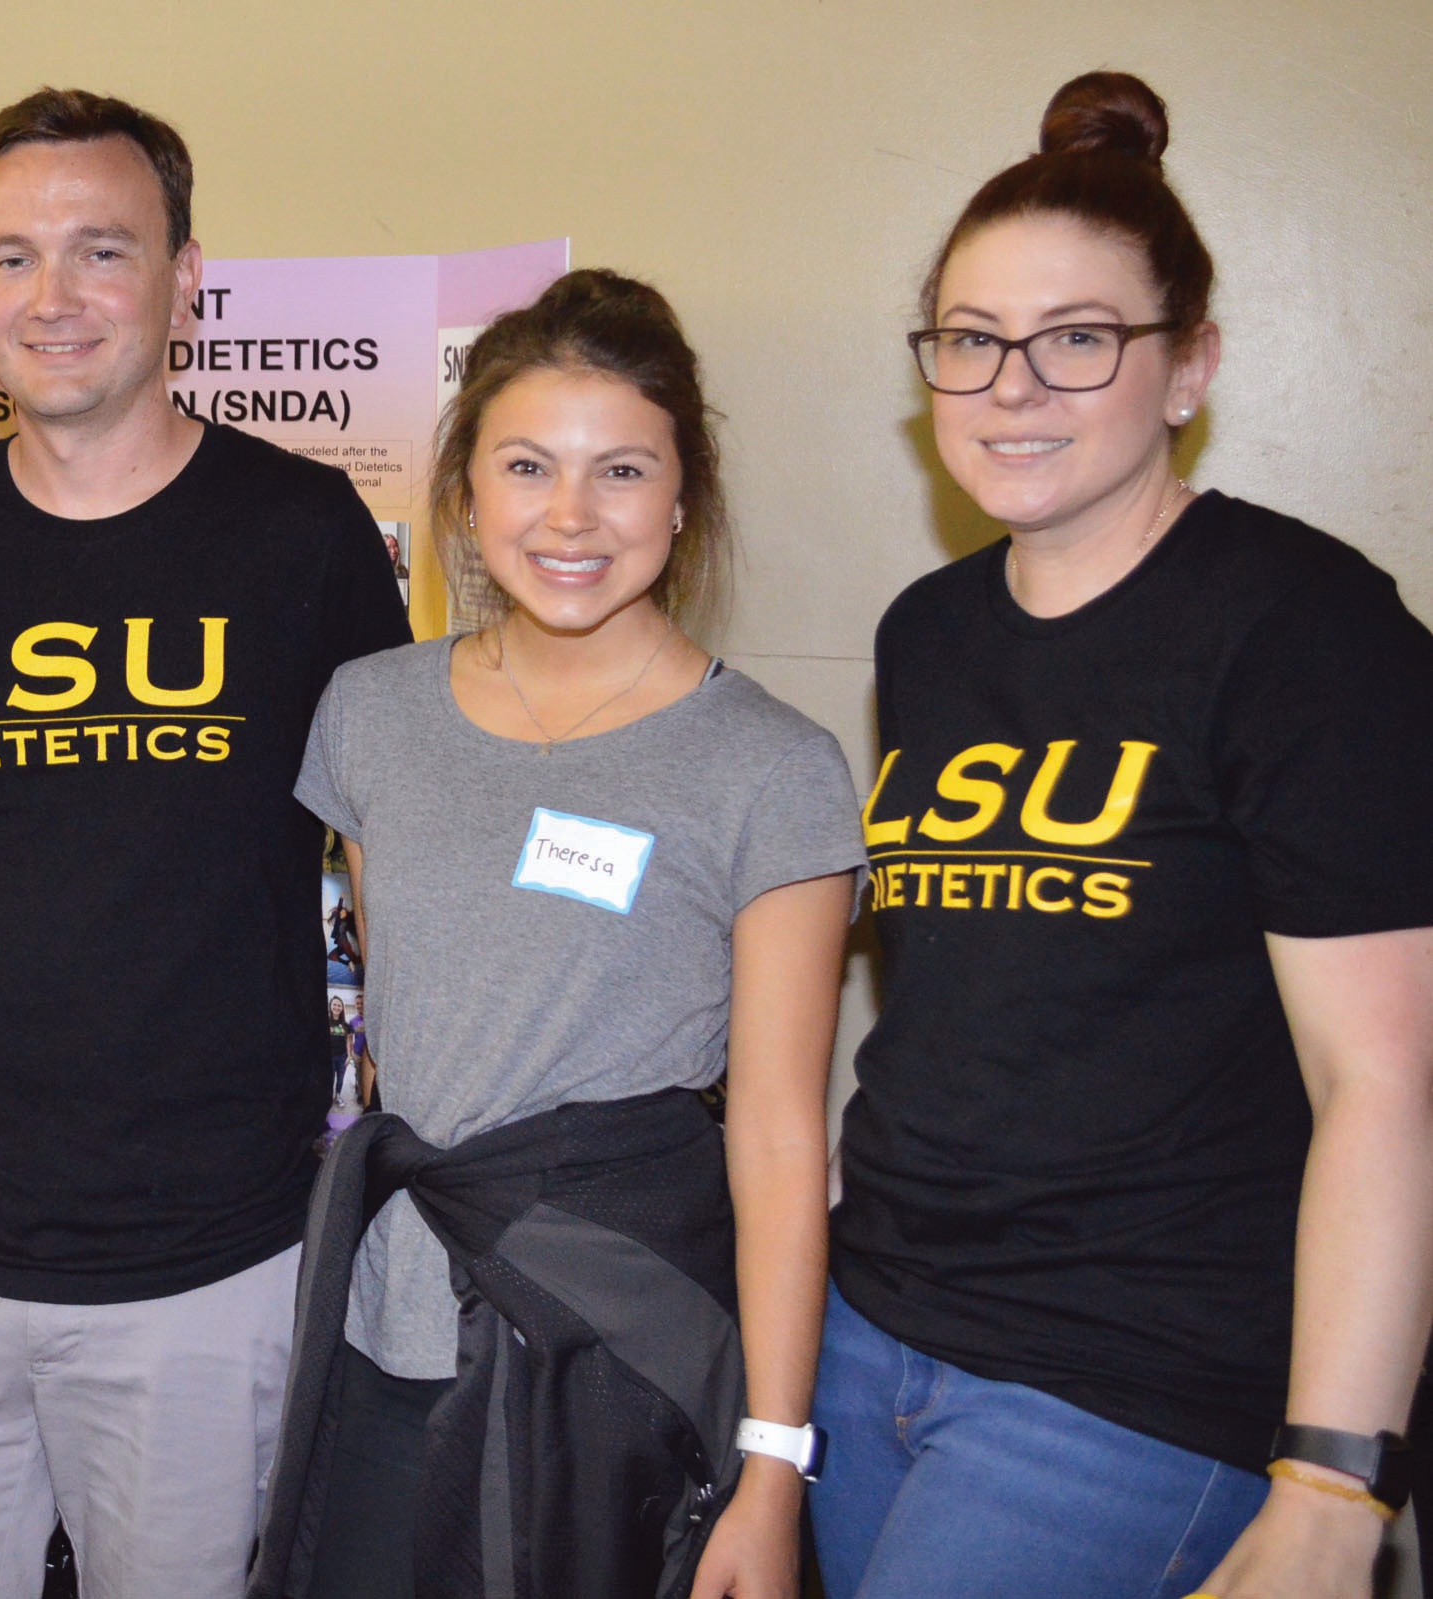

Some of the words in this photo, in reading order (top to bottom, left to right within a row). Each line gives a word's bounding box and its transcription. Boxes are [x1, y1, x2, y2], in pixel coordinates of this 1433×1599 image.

[191, 288, 231, 320] NT
[169, 338, 379, 371] DIETETICS
[211, 389, 352, 430] (SNDA)
[291, 446, 339, 457] modeled
[342, 446, 367, 457] after
[370, 447, 387, 457] the
[355, 462, 402, 472] Dietetics
[862, 739, 1159, 848] LSU
[536, 838, 614, 876] Theresa
